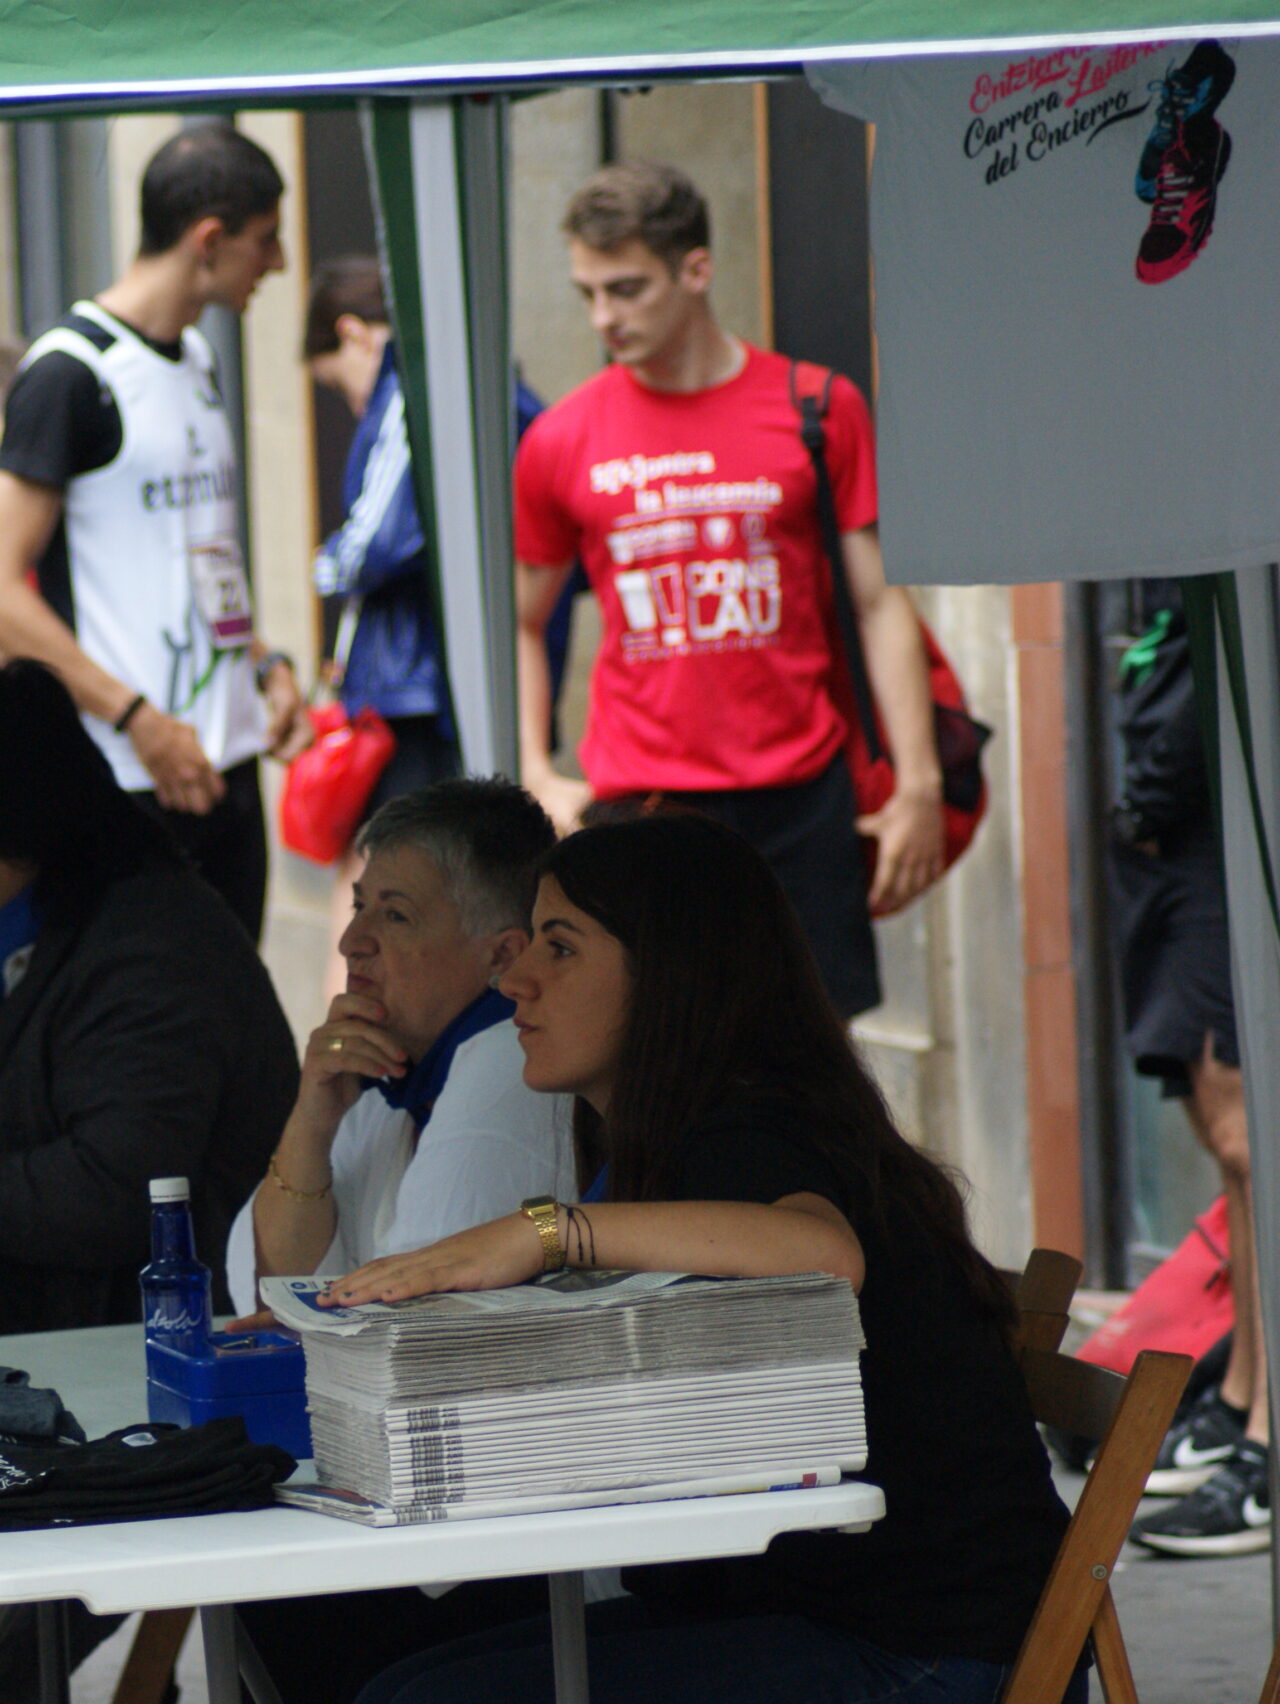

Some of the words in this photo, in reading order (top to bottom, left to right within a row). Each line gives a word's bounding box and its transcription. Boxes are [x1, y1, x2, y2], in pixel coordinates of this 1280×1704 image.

[964, 91, 1061, 158] Carrera
[985, 142, 1018, 185] del
[1026, 90, 1138, 161] Encierro
